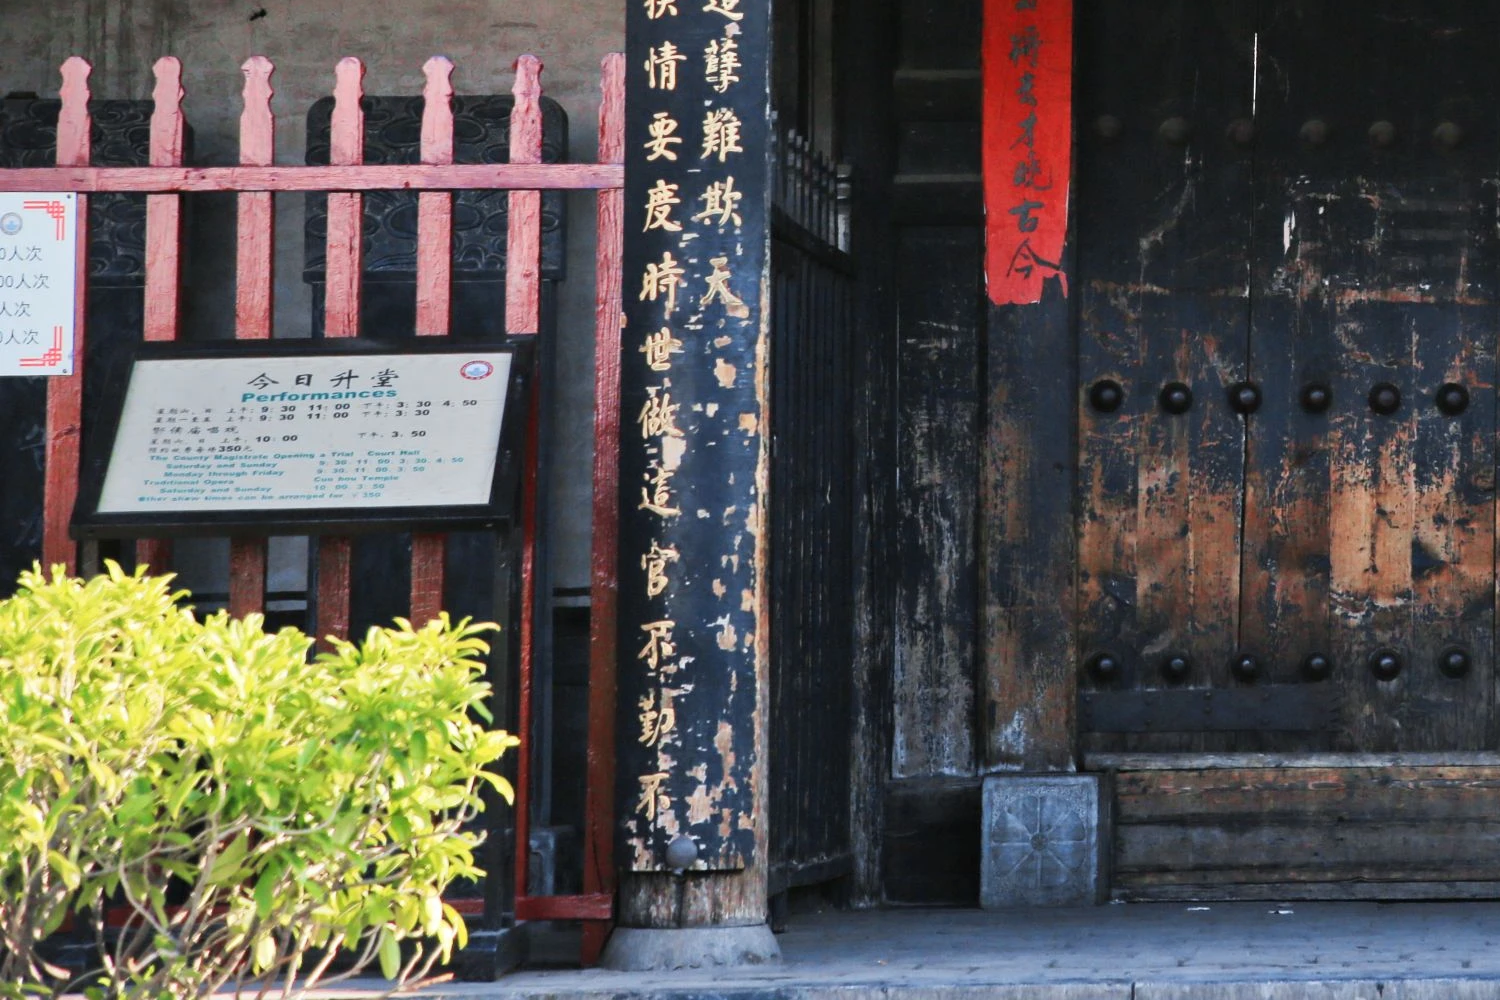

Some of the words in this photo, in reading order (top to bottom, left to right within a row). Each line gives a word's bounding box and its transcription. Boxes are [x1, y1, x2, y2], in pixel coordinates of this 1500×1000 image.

[247, 368, 399, 390] 今日升堂
[241, 389, 397, 402] Performances
